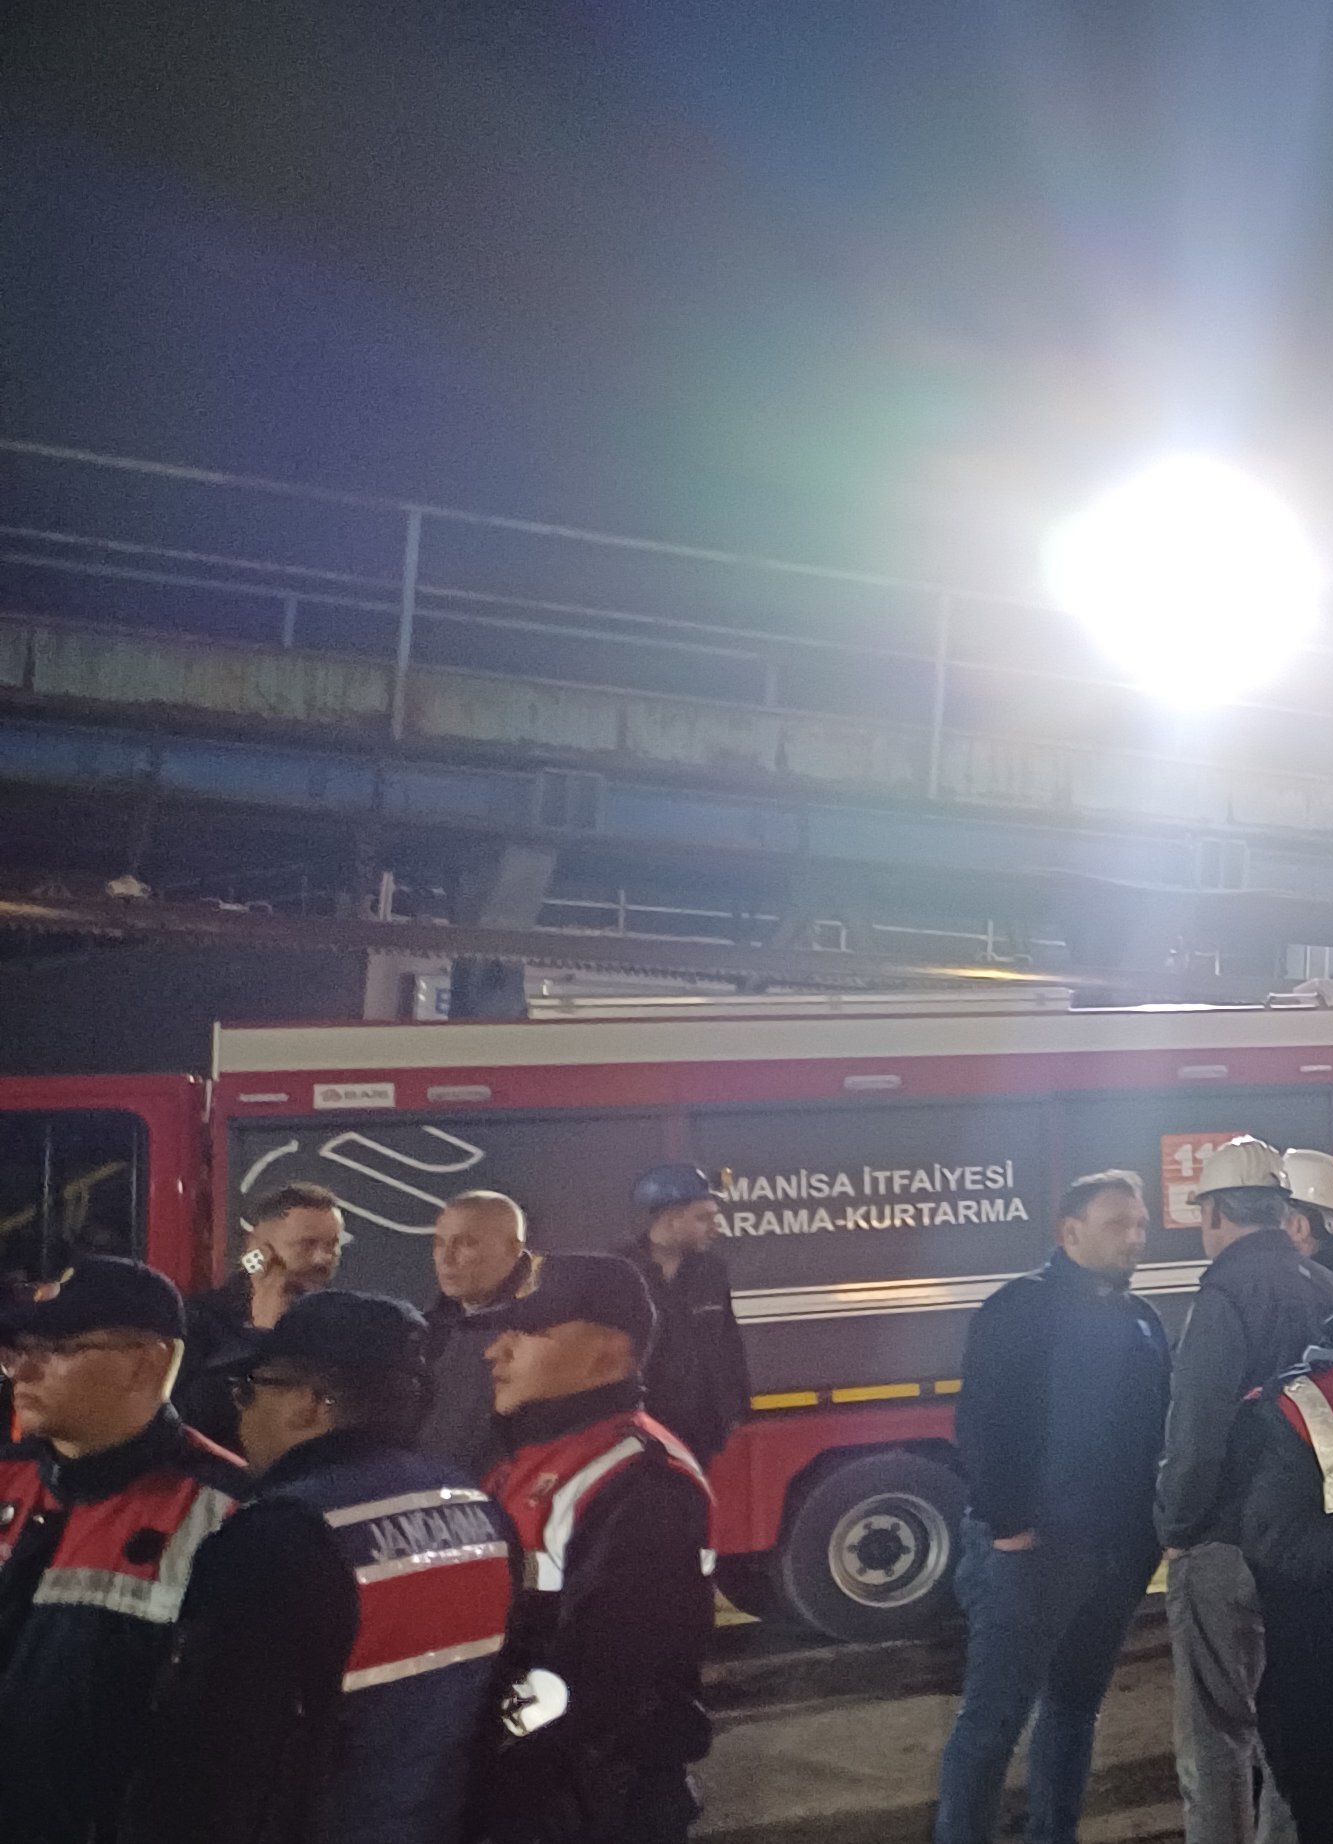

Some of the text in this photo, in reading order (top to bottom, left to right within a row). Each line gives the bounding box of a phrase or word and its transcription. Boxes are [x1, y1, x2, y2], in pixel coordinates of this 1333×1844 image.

[727, 1160, 1014, 1201] MANİSA İTFAİYESİ
[714, 1197, 1028, 1237] ARAMA-KURTARMA
